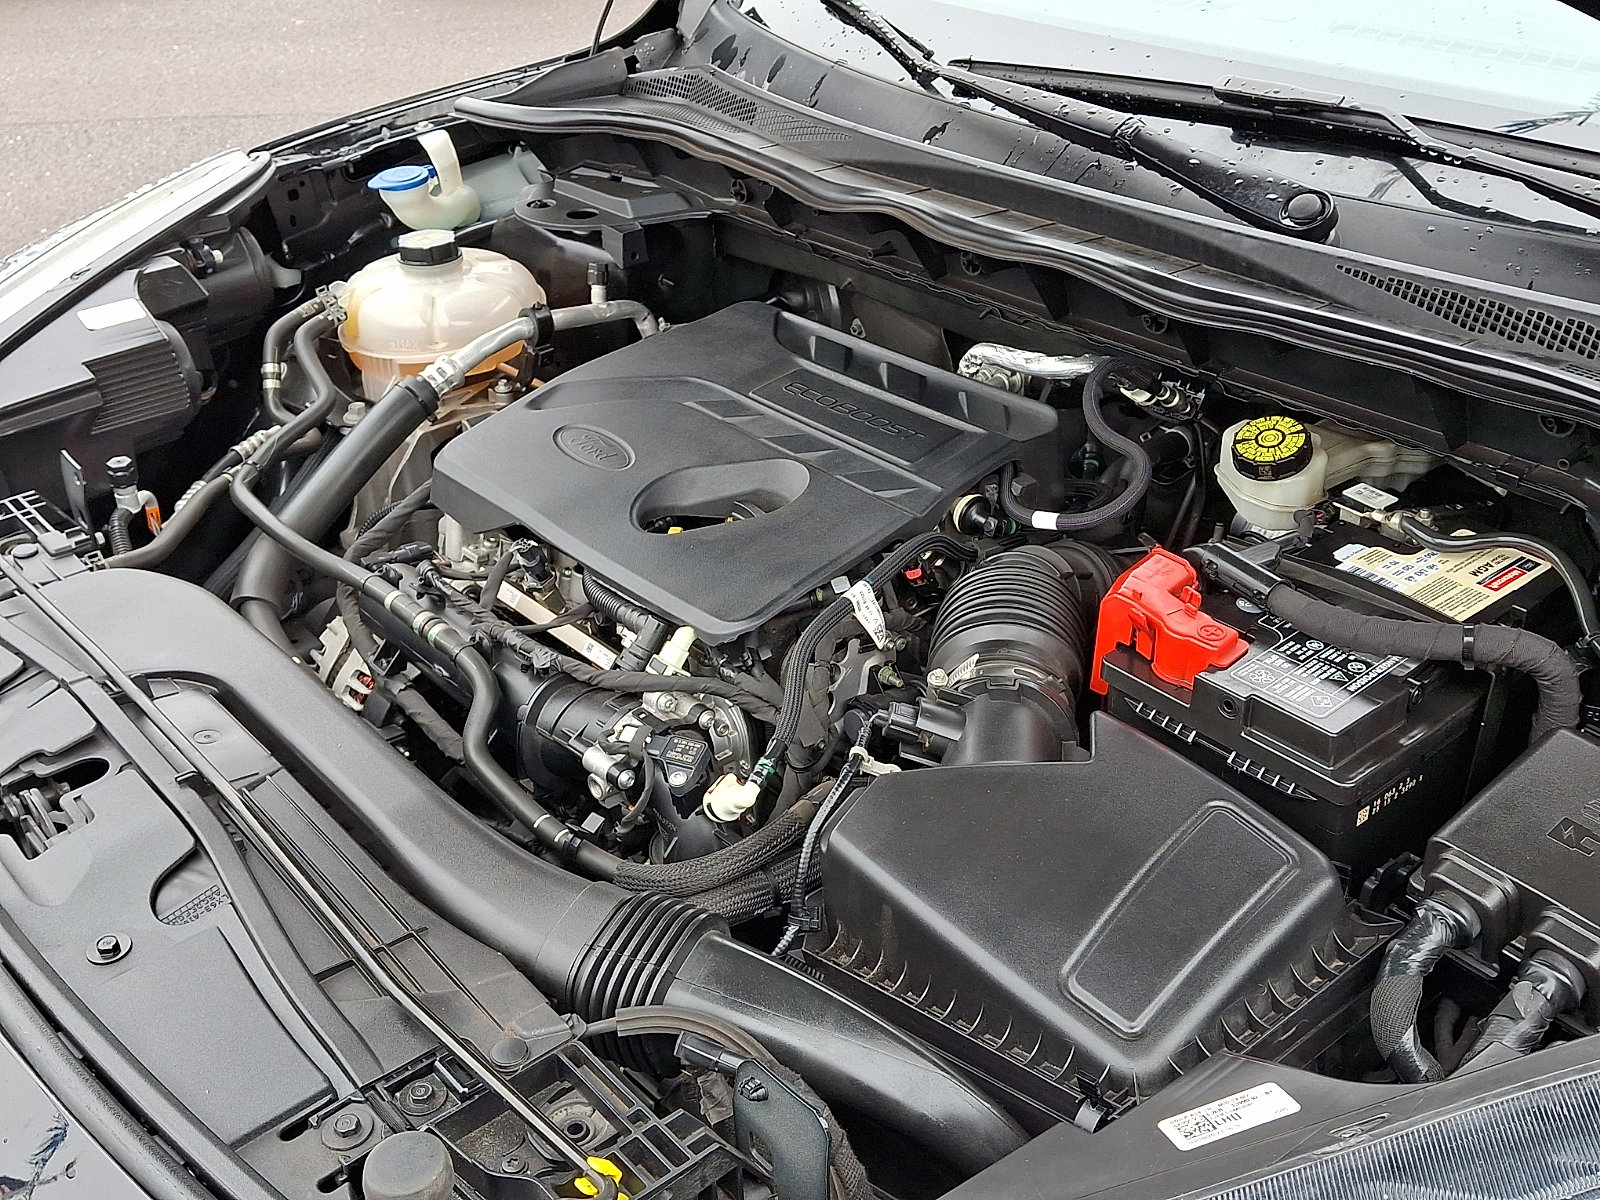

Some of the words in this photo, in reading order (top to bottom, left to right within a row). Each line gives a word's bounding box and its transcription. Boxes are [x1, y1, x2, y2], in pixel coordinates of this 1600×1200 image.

[782, 381, 926, 440] ECOBOOST
[568, 433, 619, 461] Ford
[1469, 562, 1494, 577] AGM
[1491, 569, 1521, 589] Motorcraft
